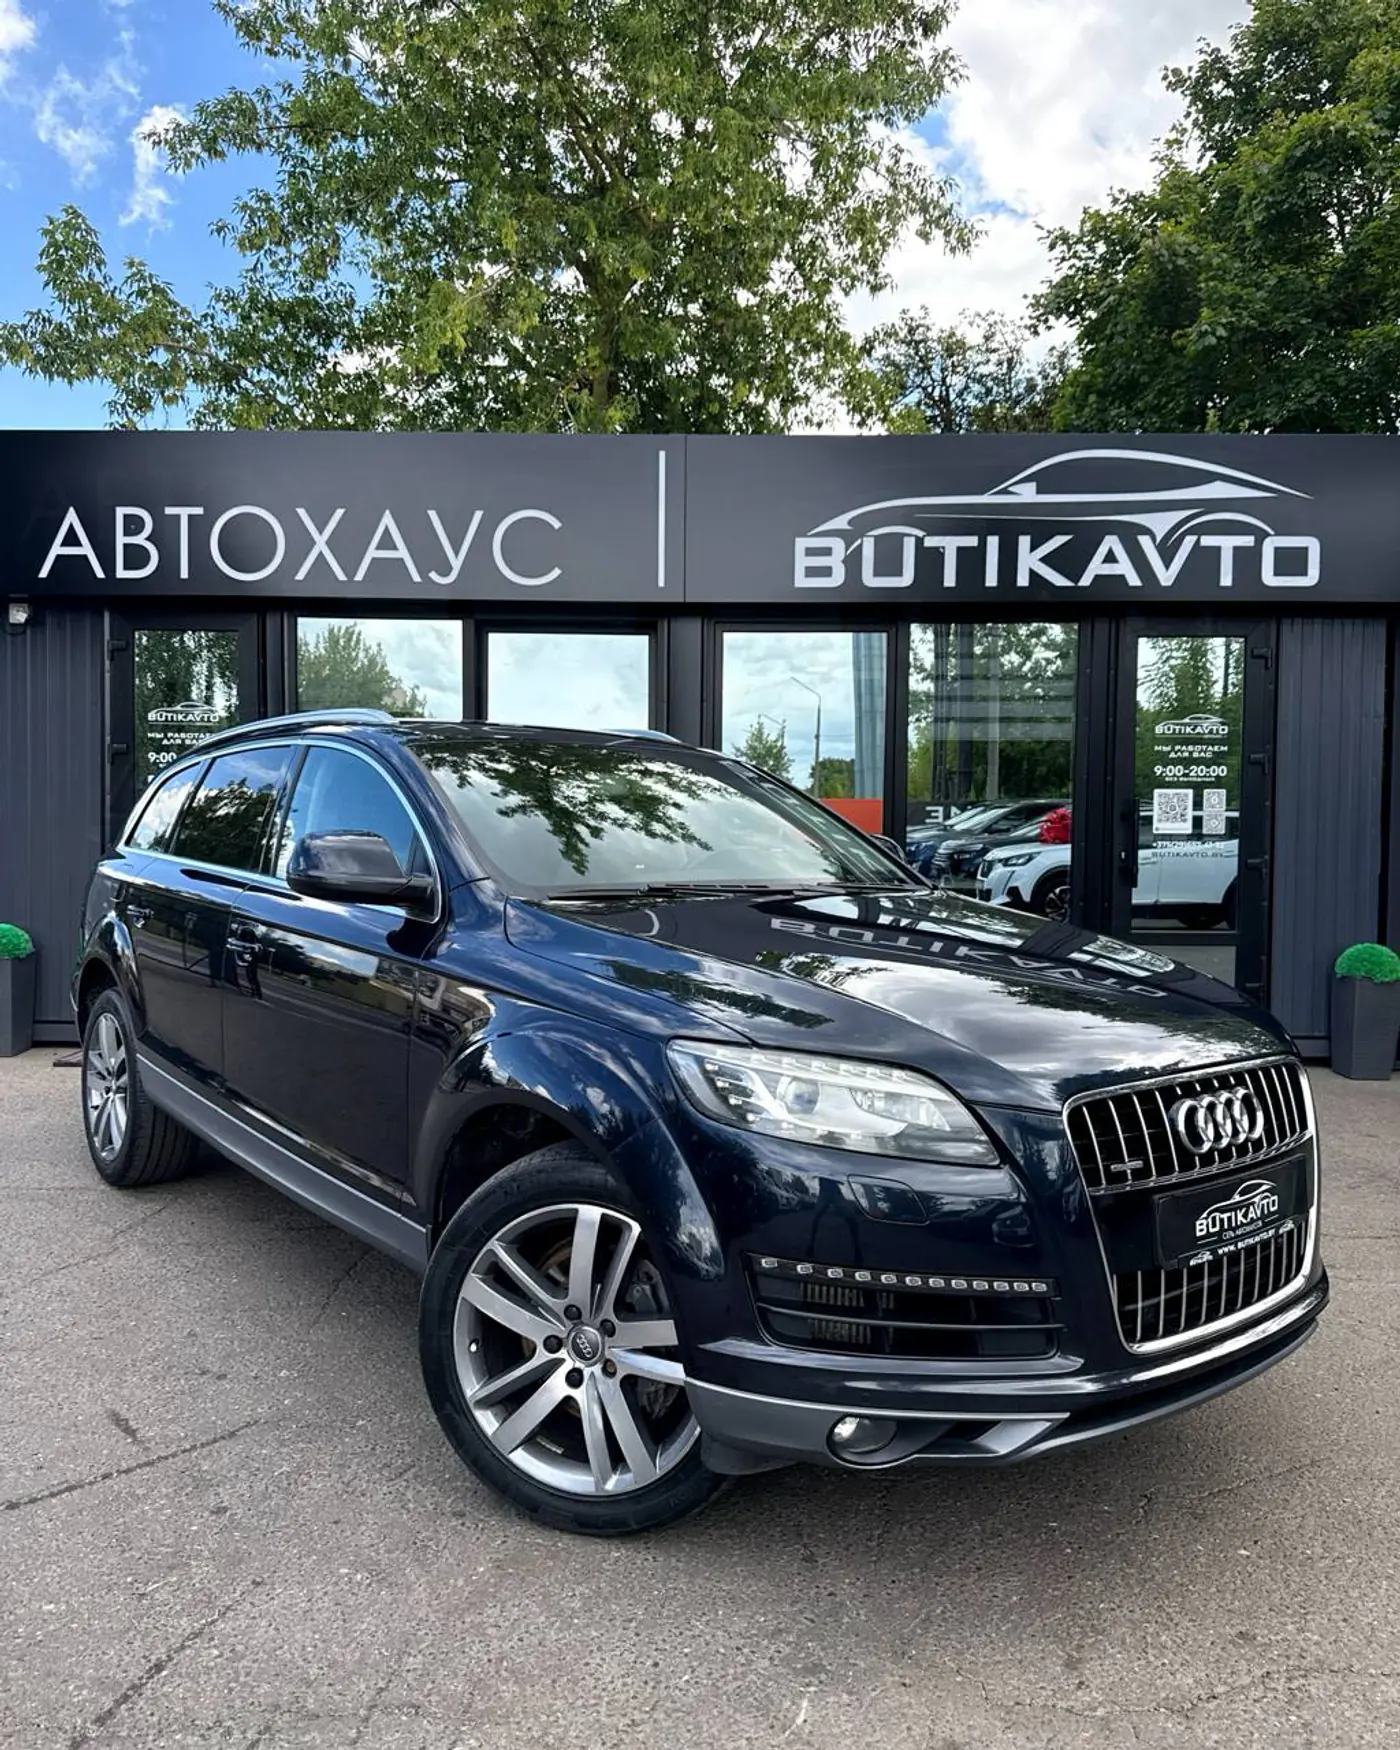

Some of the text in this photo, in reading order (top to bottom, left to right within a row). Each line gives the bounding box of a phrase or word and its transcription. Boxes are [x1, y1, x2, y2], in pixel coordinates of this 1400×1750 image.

[39, 506, 563, 585] АВТОХАУС
[794, 535, 1321, 588] BUTIKAVTO
[148, 712, 219, 722] BUTIKAVTO
[1155, 725, 1229, 734] BUTIKAVTO
[1154, 765, 1228, 777] 9:00-20:00
[1195, 1194, 1279, 1237] BUTIKAVTO
